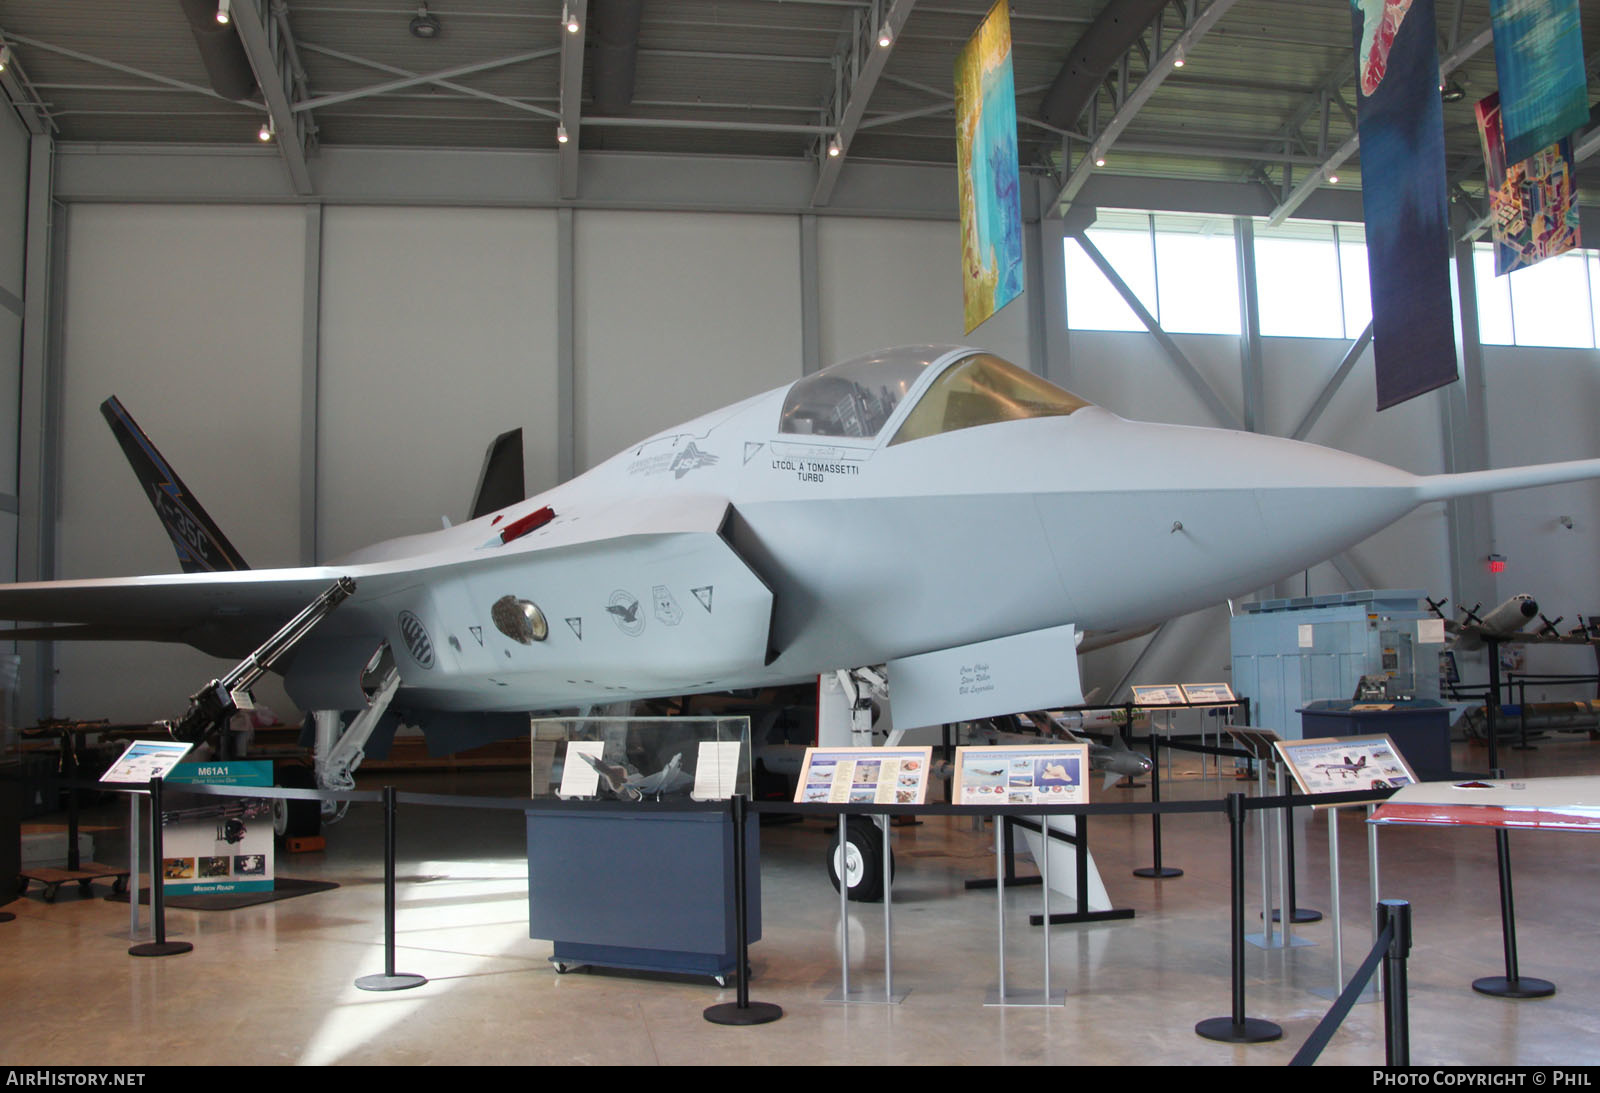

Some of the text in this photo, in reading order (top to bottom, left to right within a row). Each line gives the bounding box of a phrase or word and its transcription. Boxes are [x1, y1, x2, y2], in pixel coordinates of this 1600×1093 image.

[772, 460, 859, 475] LTCOL A TOMASSETTI
[798, 472, 824, 483] TURBO
[152, 483, 208, 559] X-35C
[198, 767, 229, 776] M61A1
